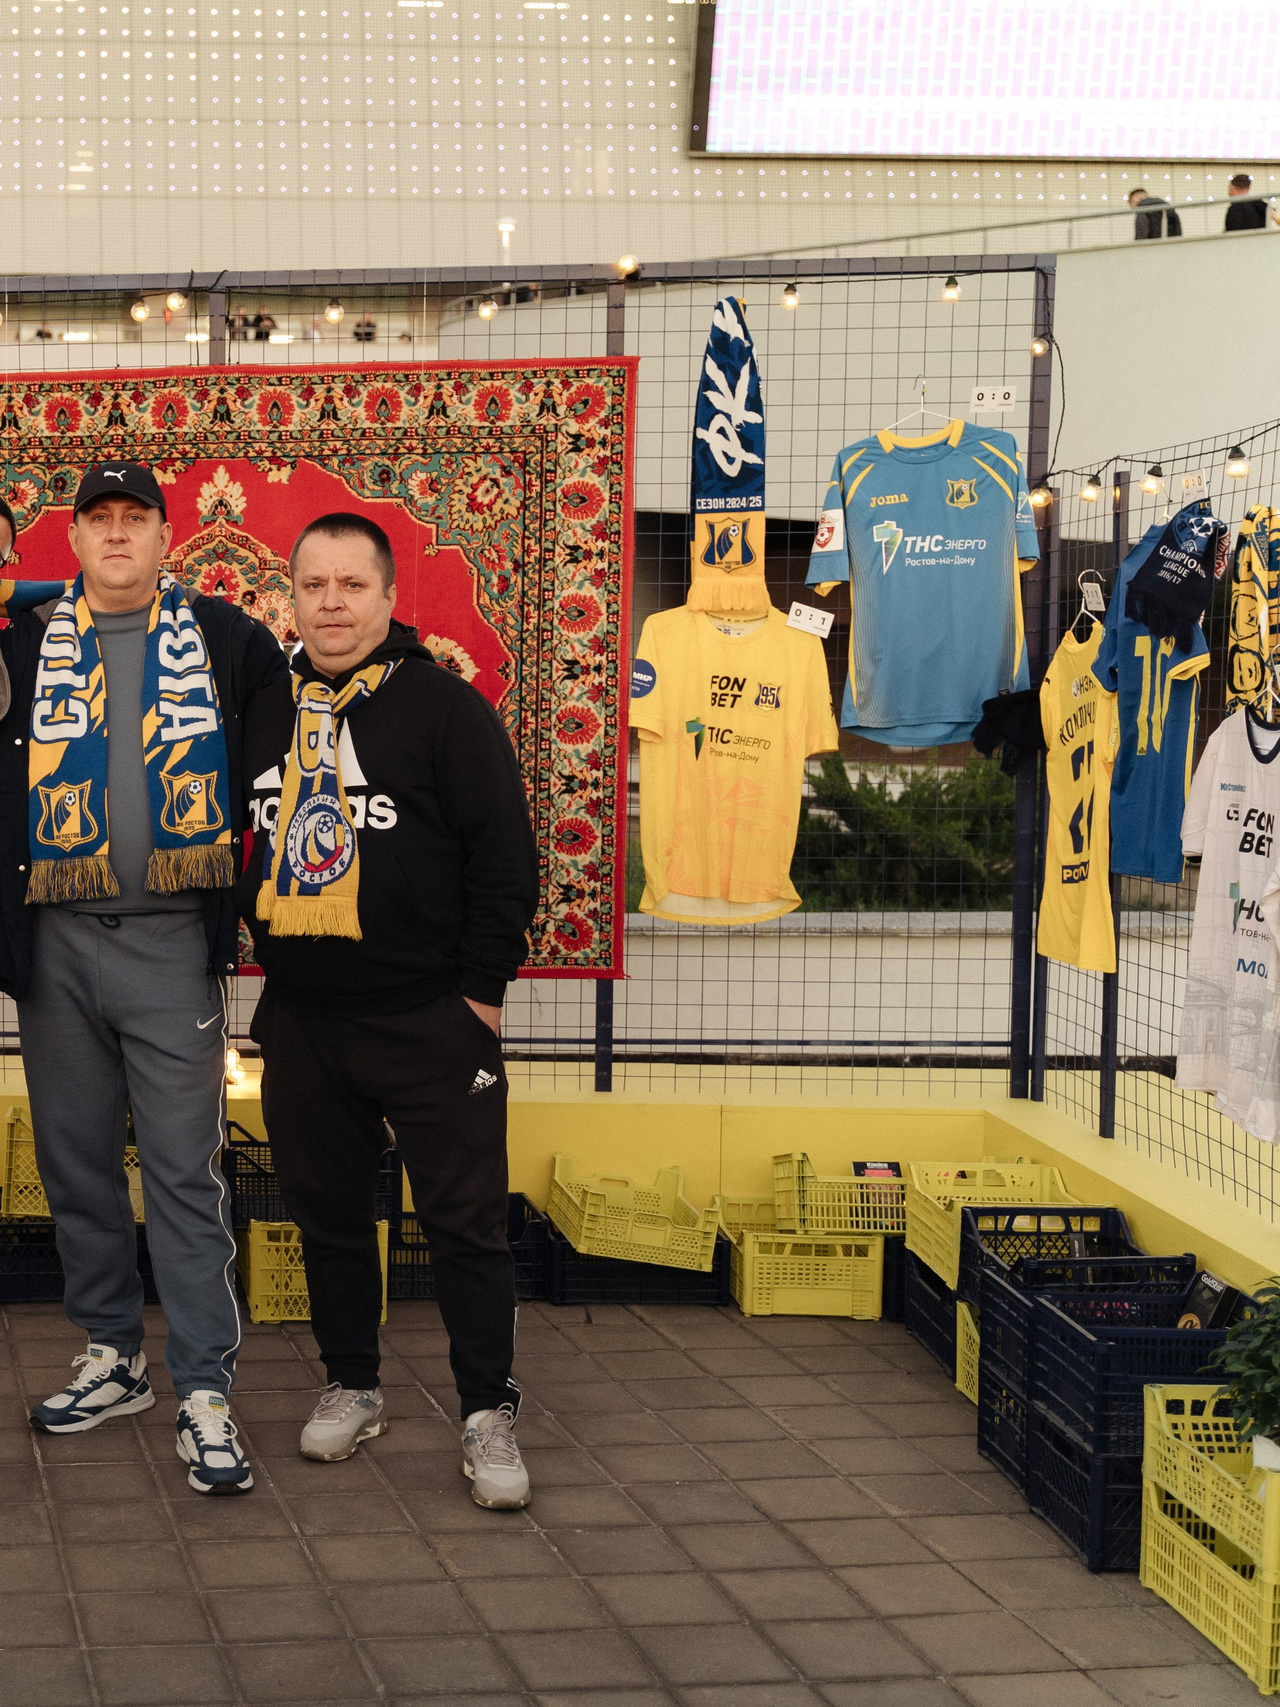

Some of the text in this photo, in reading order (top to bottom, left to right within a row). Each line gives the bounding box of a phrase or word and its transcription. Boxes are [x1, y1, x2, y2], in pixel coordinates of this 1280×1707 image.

[695, 496, 763, 510] СЕЗОН 2024/25
[904, 535, 987, 554] ТНС ЭНЕРГО
[905, 556, 976, 568] Ростов-на-Дону
[1158, 544, 1207, 580] CHAMPIONS
[1163, 560, 1191, 579] LEAGUE
[711, 675, 746, 692] FON
[711, 692, 742, 708] BET
[760, 686, 776, 704] 95
[733, 735, 771, 750] ЭНЕРГО
[248, 794, 398, 833] adas
[1239, 834, 1274, 859] BET
[292, 858, 345, 882] РОСТОВ
[1239, 898, 1266, 922] НС
[1201, 1273, 1223, 1293] GoldStar
